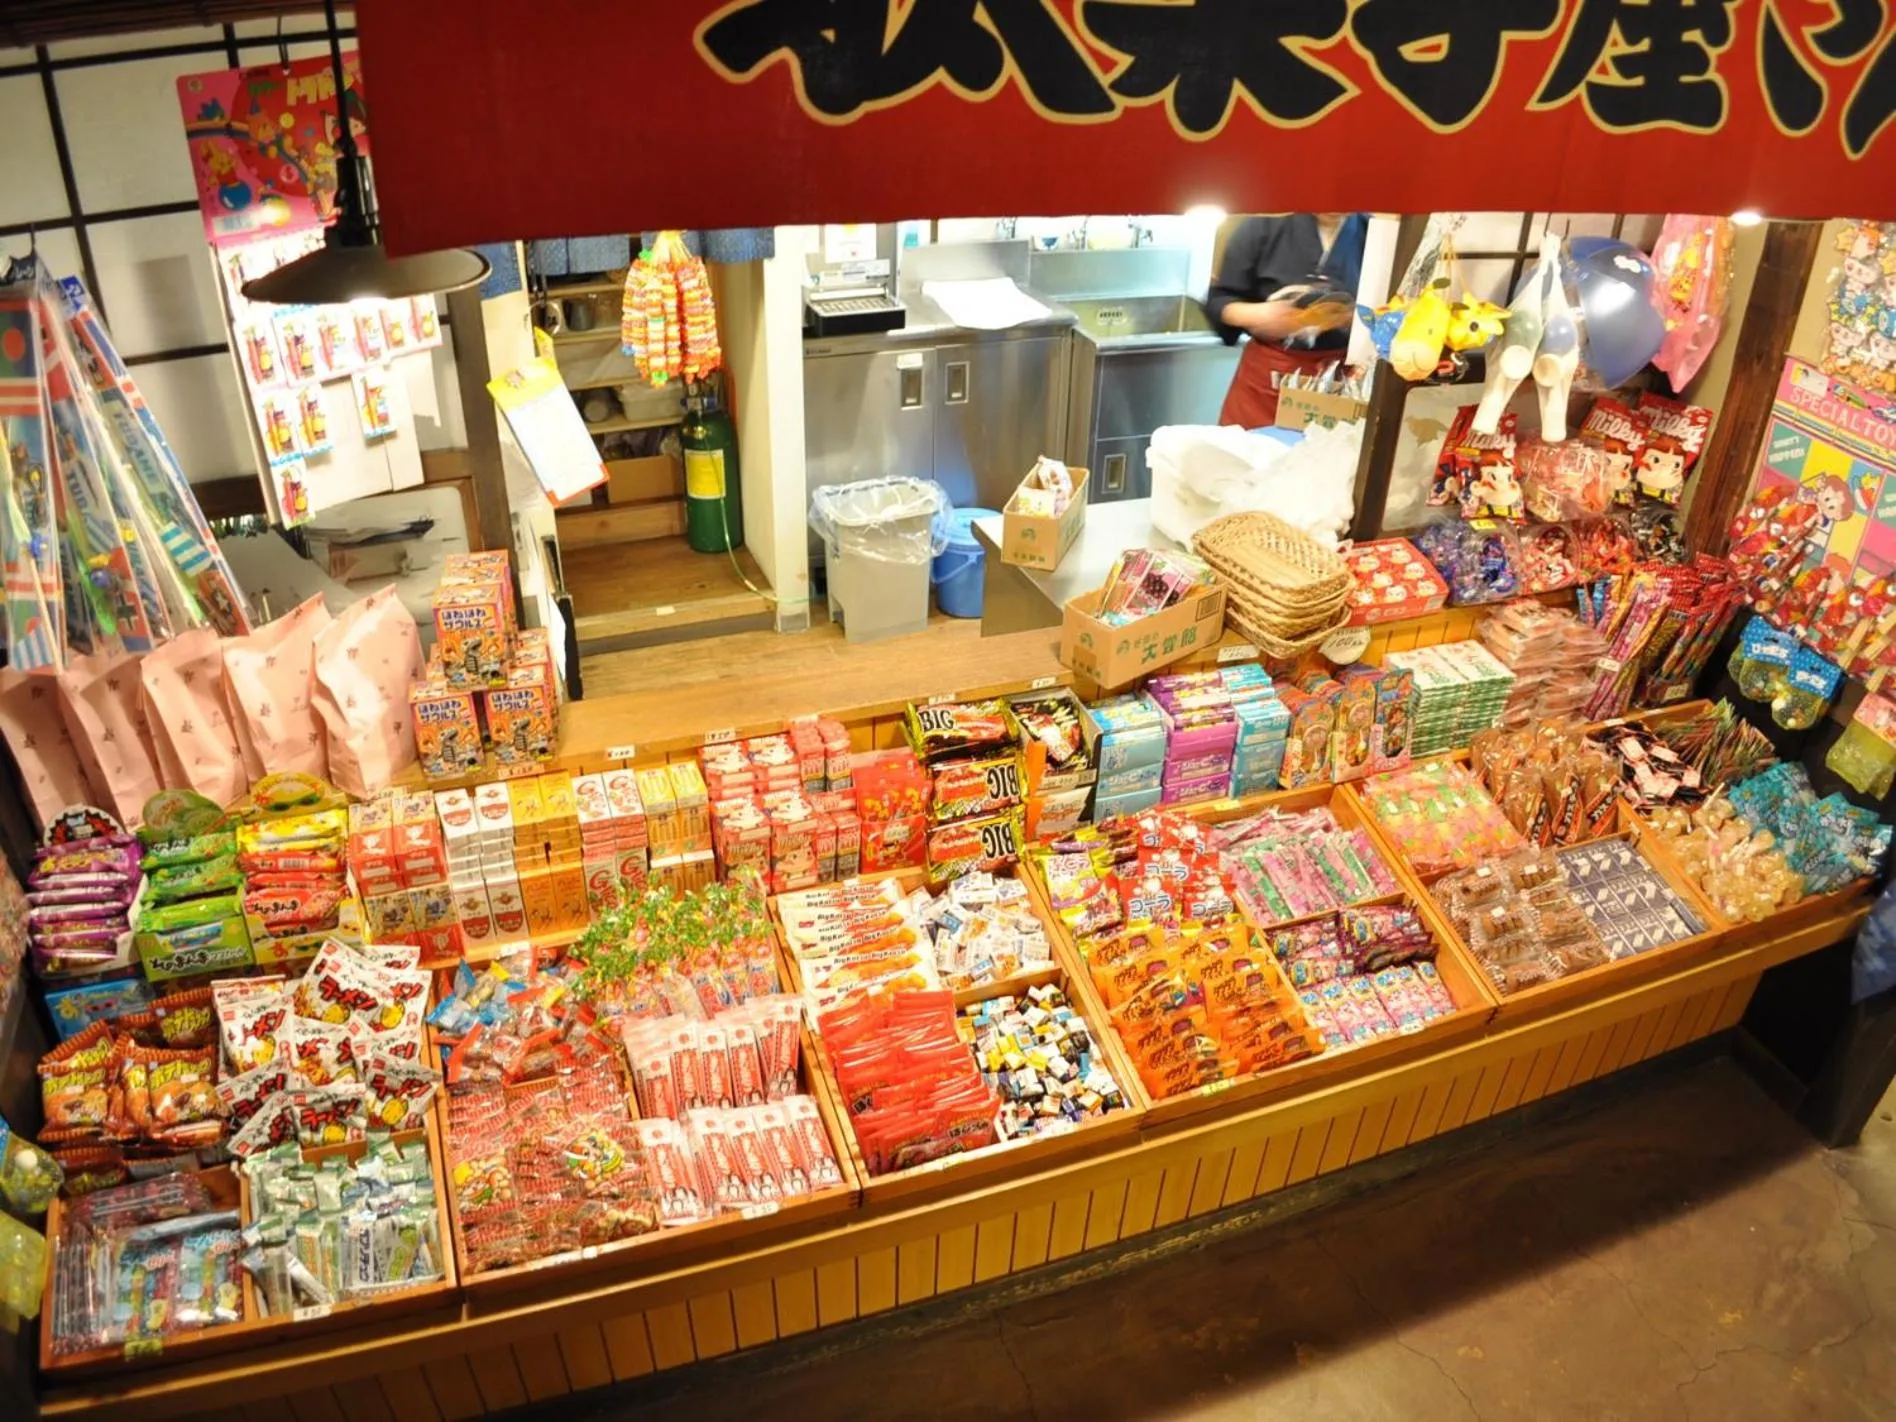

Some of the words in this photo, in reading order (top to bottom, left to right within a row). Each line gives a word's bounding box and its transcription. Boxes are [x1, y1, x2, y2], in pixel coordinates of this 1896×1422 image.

[1790, 386, 1862, 424] SPECIAL
[1587, 409, 1645, 452] Milky
[1641, 405, 1706, 453] Milky
[918, 709, 955, 733] BIG
[986, 764, 1020, 800] BIG
[981, 822, 1016, 859] BIG
[1145, 863, 1189, 881] コーラ
[1129, 893, 1172, 913] コーラ
[1191, 899, 1235, 917] コーラ
